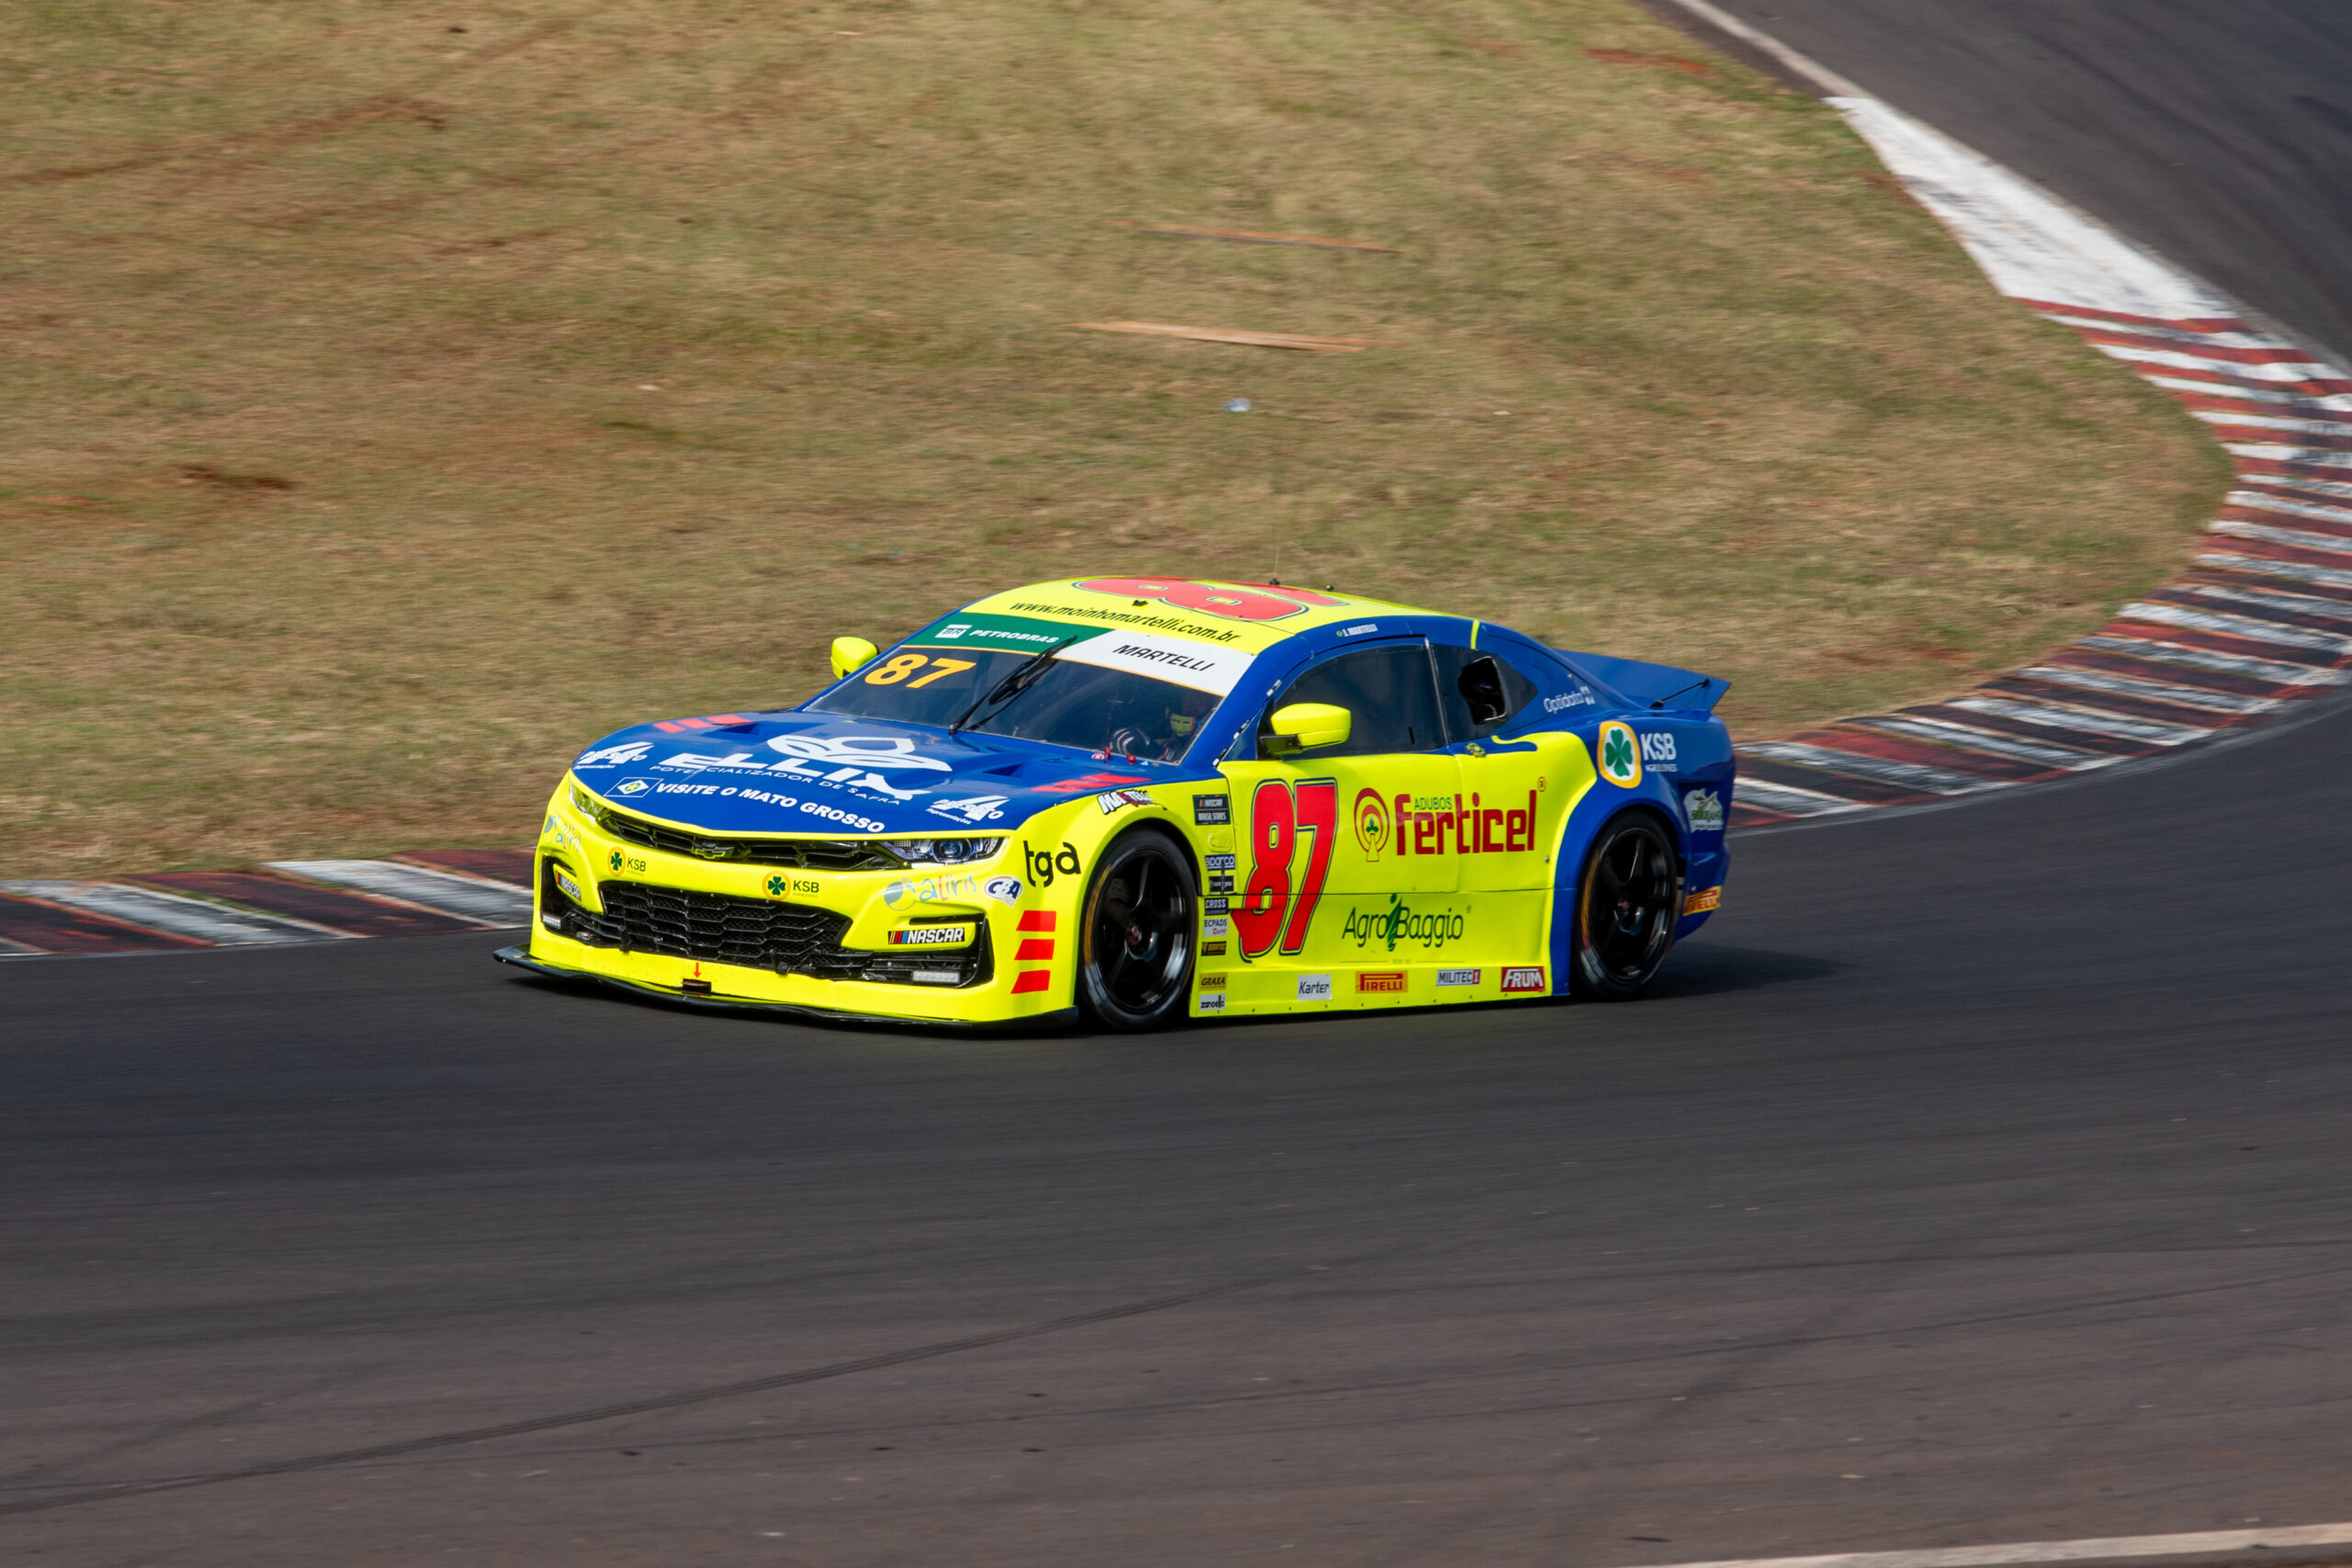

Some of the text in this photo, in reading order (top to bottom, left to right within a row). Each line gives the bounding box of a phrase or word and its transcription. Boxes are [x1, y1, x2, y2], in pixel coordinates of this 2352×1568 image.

[1010, 602, 1241, 643] www.moinhomartelli.com.br
[969, 630, 1059, 643] PETROBRAS
[1113, 645, 1216, 671] MARTELLI
[865, 654, 977, 688] 87
[1640, 732, 1677, 761] KSB
[819, 781, 844, 789] DE
[848, 787, 900, 806] SAFRA
[656, 783, 885, 832] VISITE O MATO GROSSO
[1414, 797, 1452, 810] ADUBOS
[1395, 790, 1537, 856] ferticel
[628, 859, 646, 872] KSB
[1023, 840, 1081, 887] tga
[1205, 855, 1235, 869] sparco
[1232, 776, 1339, 963] 87
[793, 880, 820, 893] KSB
[988, 880, 1023, 900] CBA
[1205, 898, 1227, 908] CROSS
[1204, 919, 1227, 928] ECPADS
[907, 928, 964, 943] NASCAR
[1298, 981, 1329, 995] Karter
[1360, 973, 1403, 991] PIRELLI
[1502, 969, 1544, 988] FRUM
